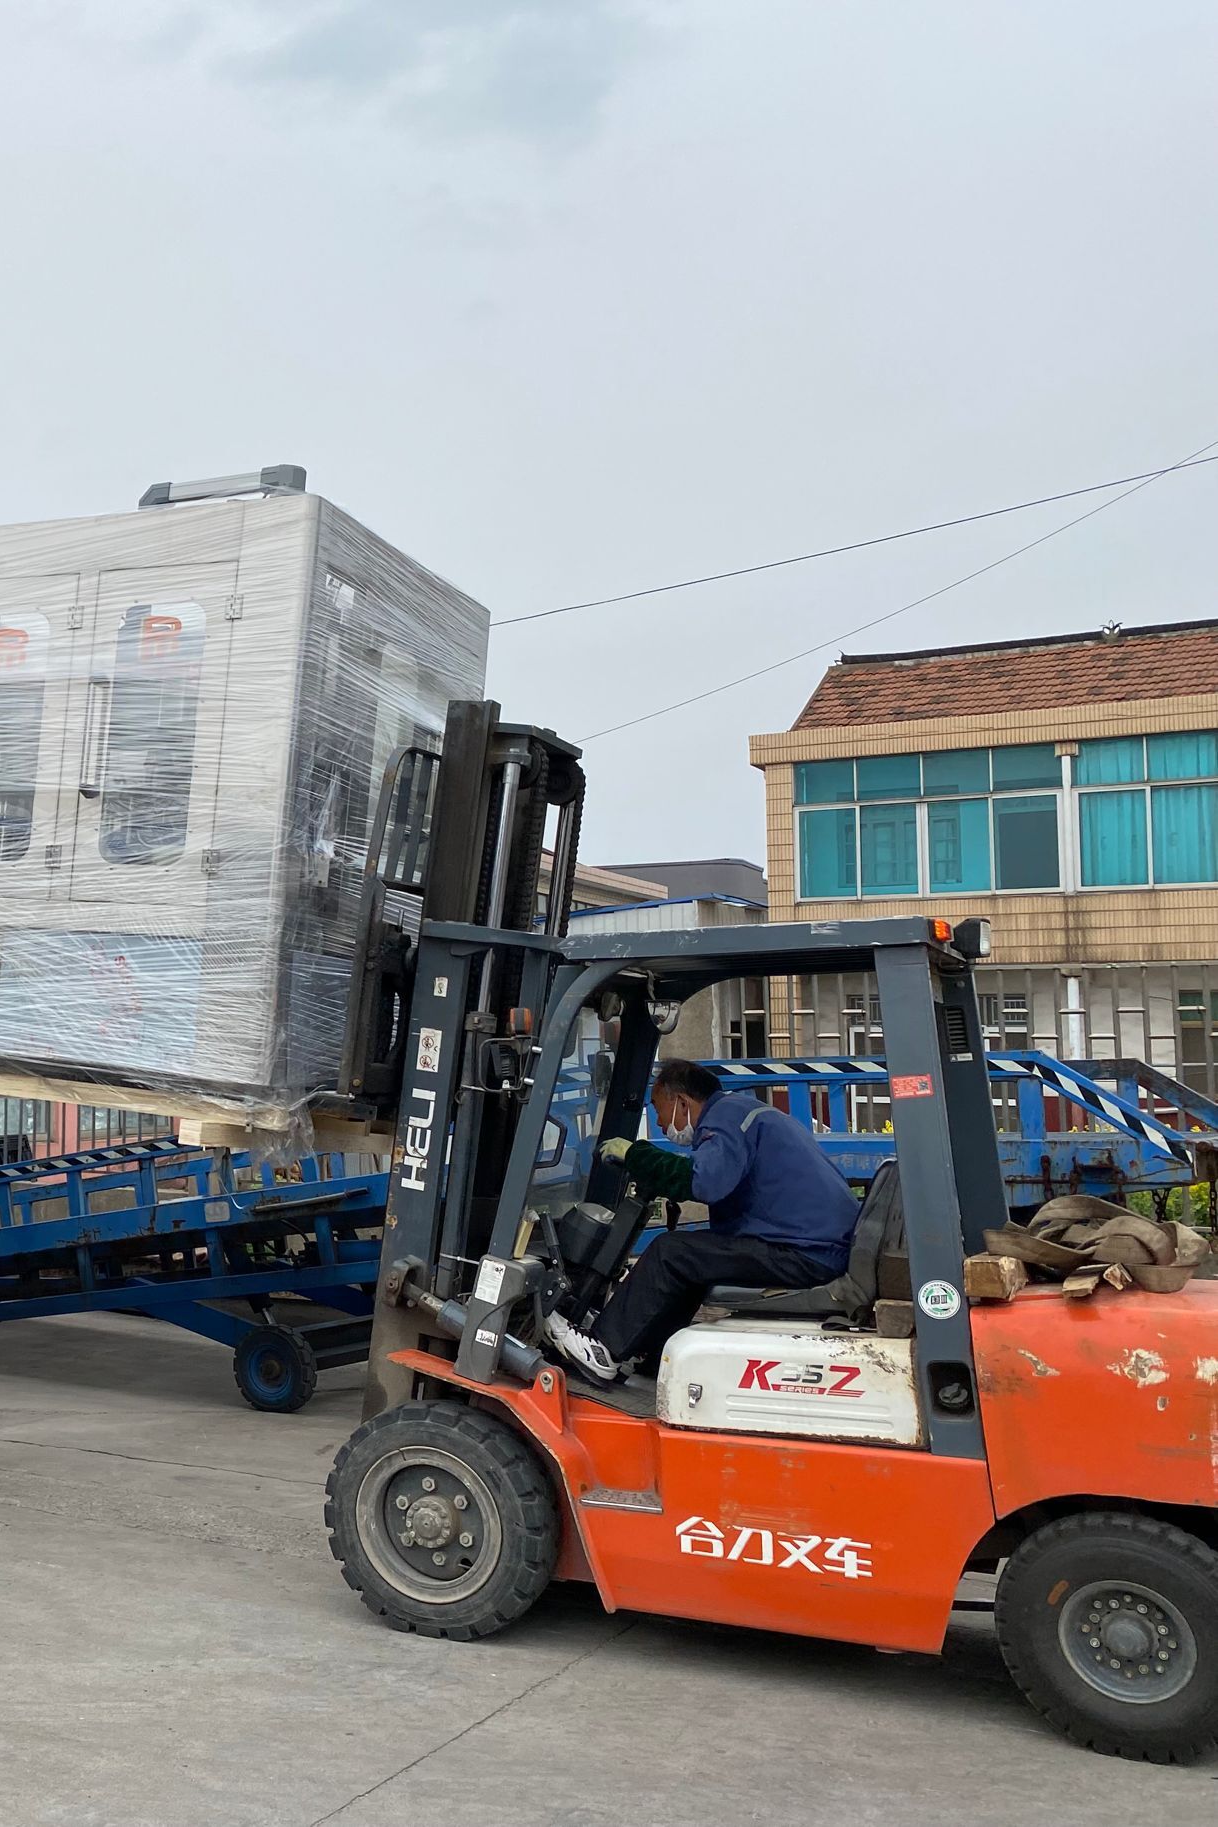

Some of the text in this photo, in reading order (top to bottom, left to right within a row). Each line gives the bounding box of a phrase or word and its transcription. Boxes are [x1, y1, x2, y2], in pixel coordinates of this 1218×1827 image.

[401, 1088, 436, 1191] HELI
[675, 1516, 873, 1579] 合力叉车
